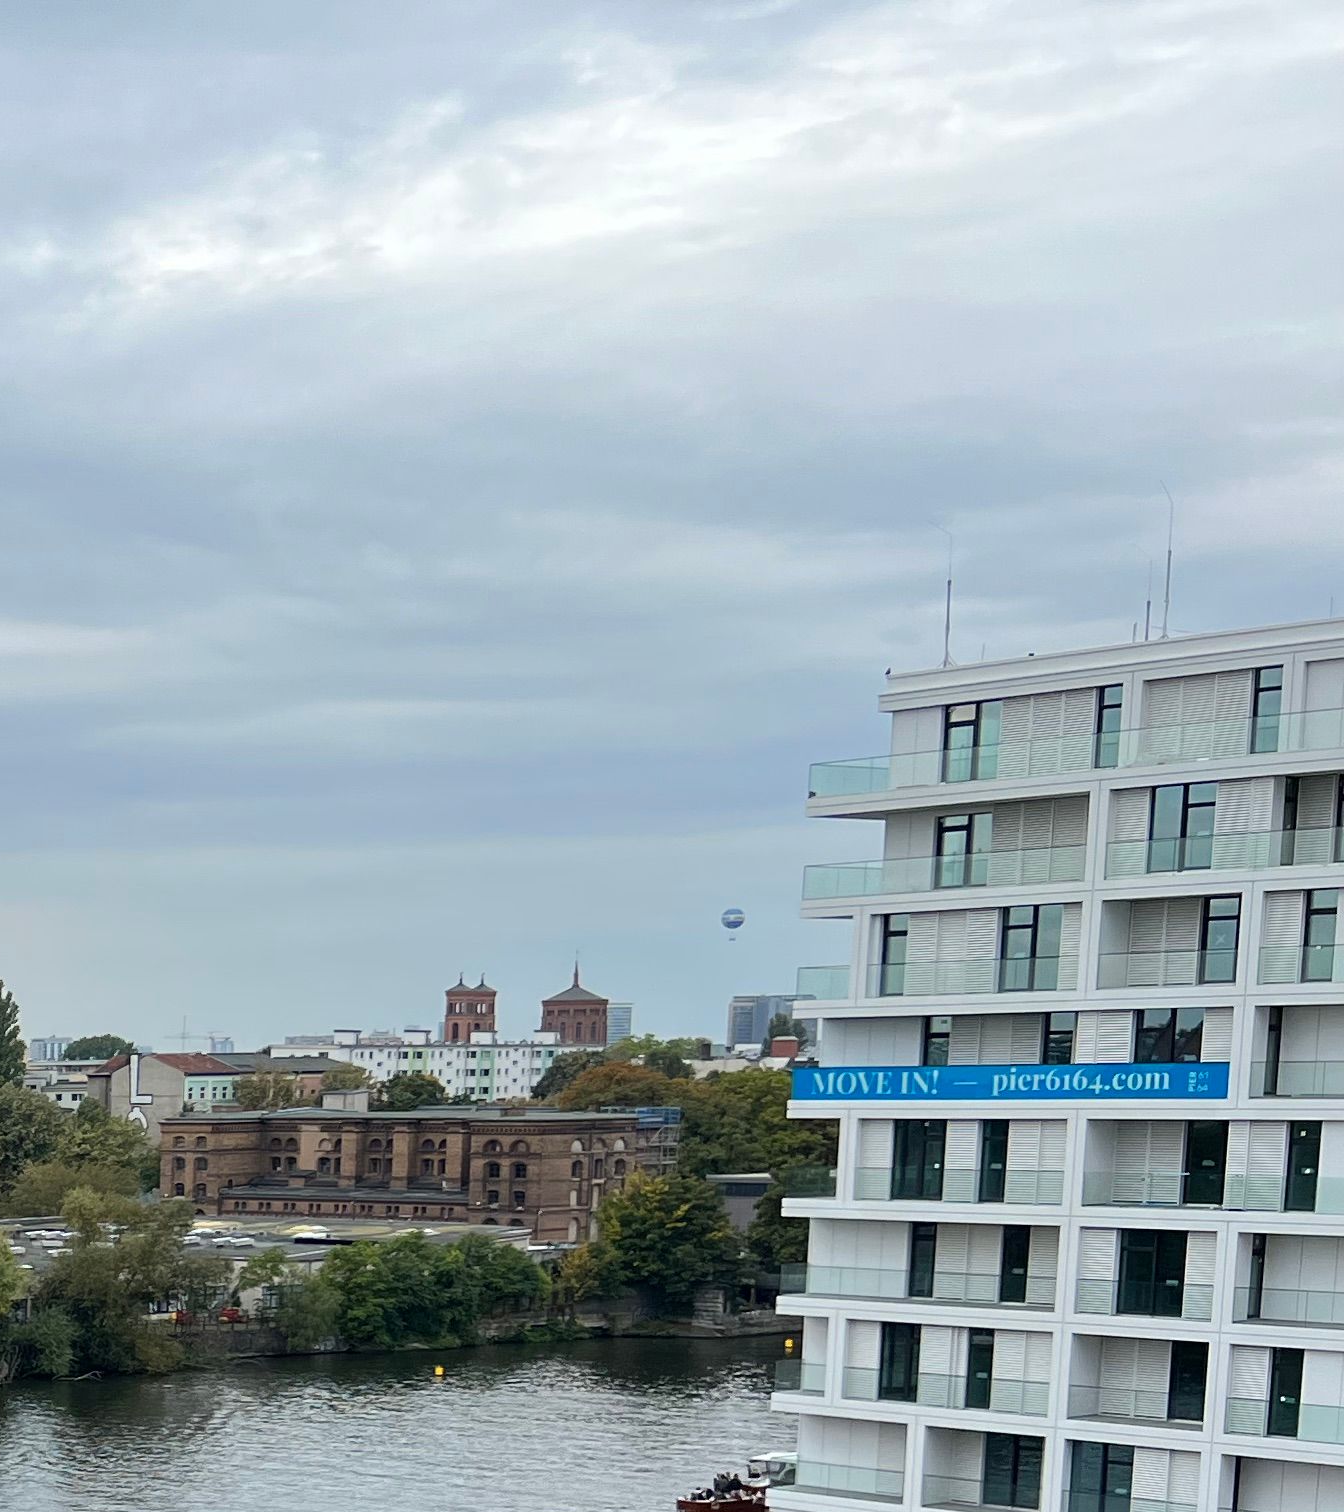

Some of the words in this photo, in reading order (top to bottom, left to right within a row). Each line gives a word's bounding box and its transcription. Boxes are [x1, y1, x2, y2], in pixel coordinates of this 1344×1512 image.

[812, 1071, 892, 1095] MOVE
[900, 1069, 940, 1095] IN!
[990, 1067, 1171, 1096] pier6164.com
